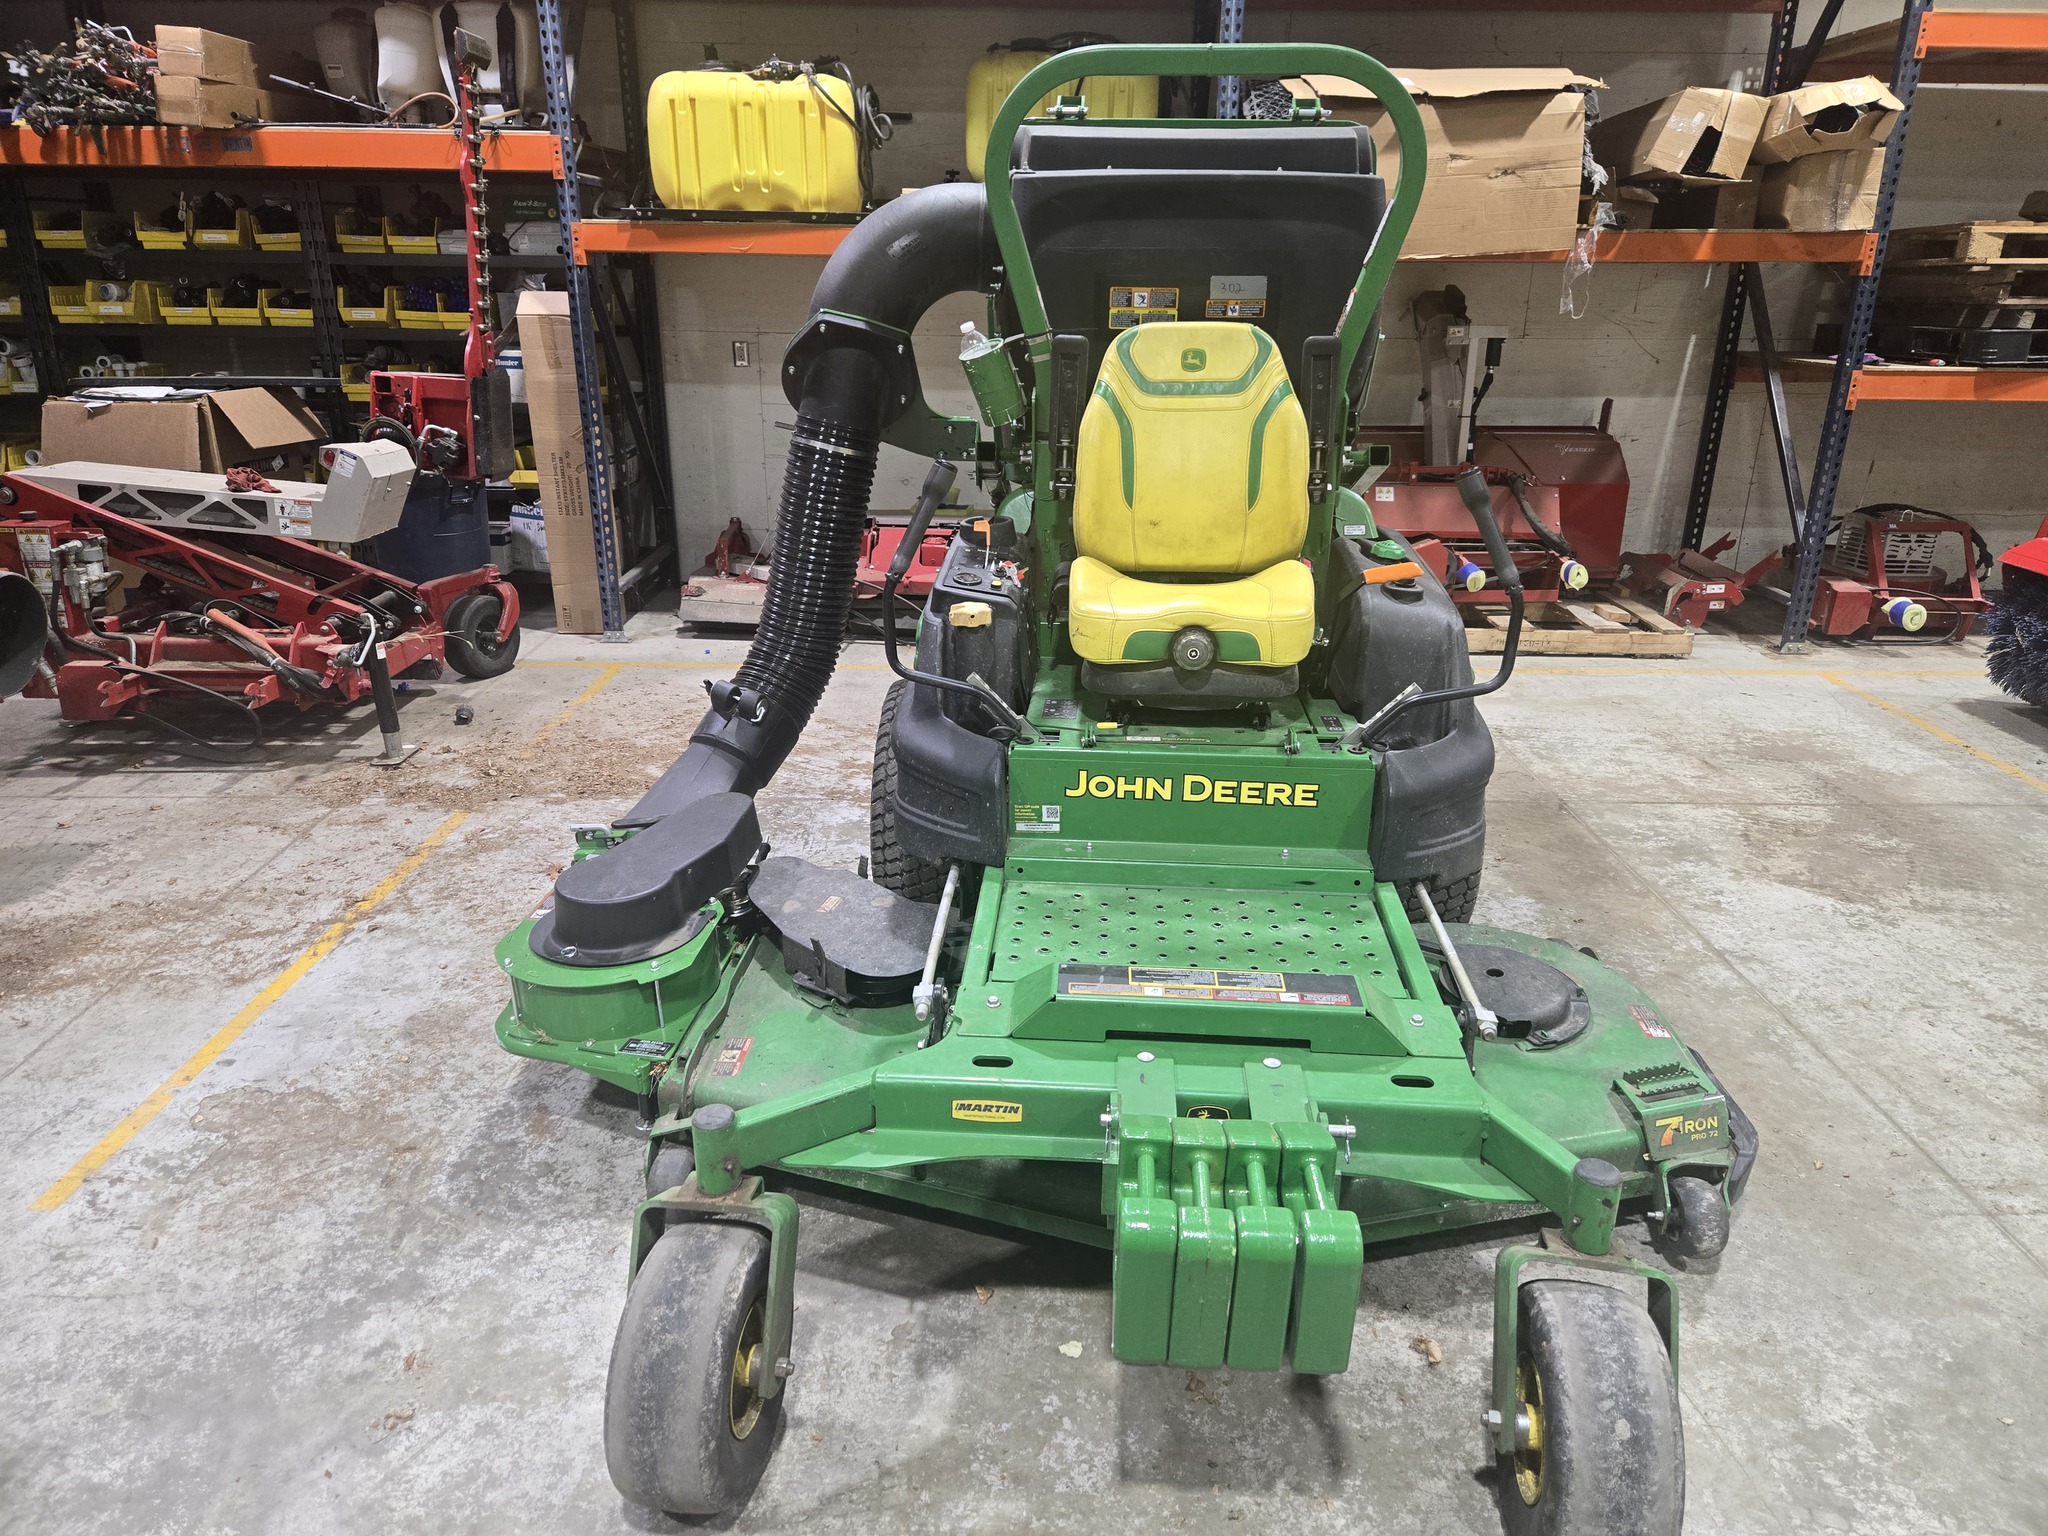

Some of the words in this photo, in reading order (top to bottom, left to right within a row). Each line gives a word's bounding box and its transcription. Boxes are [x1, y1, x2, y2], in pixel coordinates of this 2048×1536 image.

[1221, 282, 1245, 295] 302
[495, 359, 519, 367] Hunter
[1065, 769, 1173, 801] JOHN
[1182, 773, 1320, 808] DEERE
[957, 1102, 1021, 1114] MARTIN
[1691, 1132, 1707, 1141] PRO
[1709, 1130, 1719, 1138] 72
